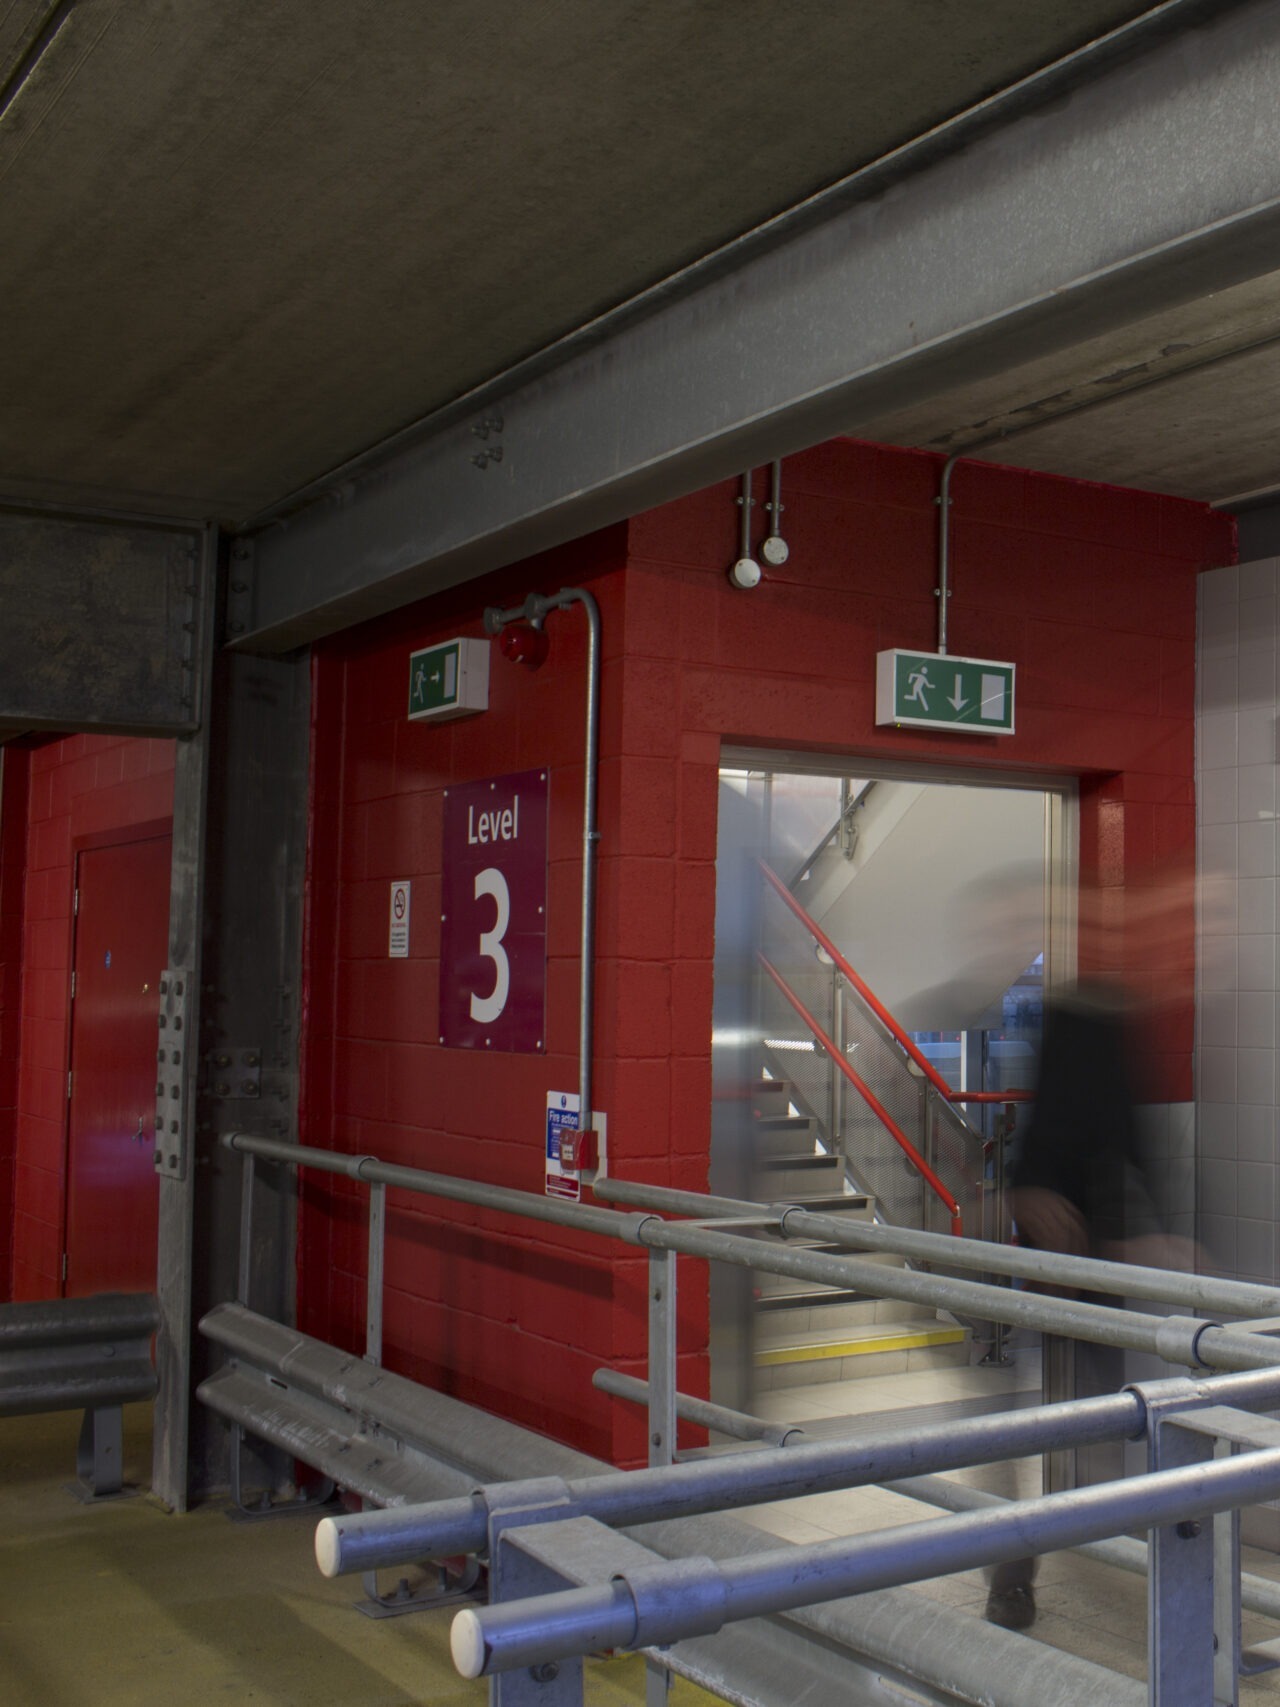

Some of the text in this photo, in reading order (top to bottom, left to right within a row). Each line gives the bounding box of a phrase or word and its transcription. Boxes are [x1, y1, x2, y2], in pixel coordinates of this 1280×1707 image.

[468, 795, 520, 845] Level
[470, 867, 511, 1024] 3
[549, 1110, 578, 1124] Fire action
